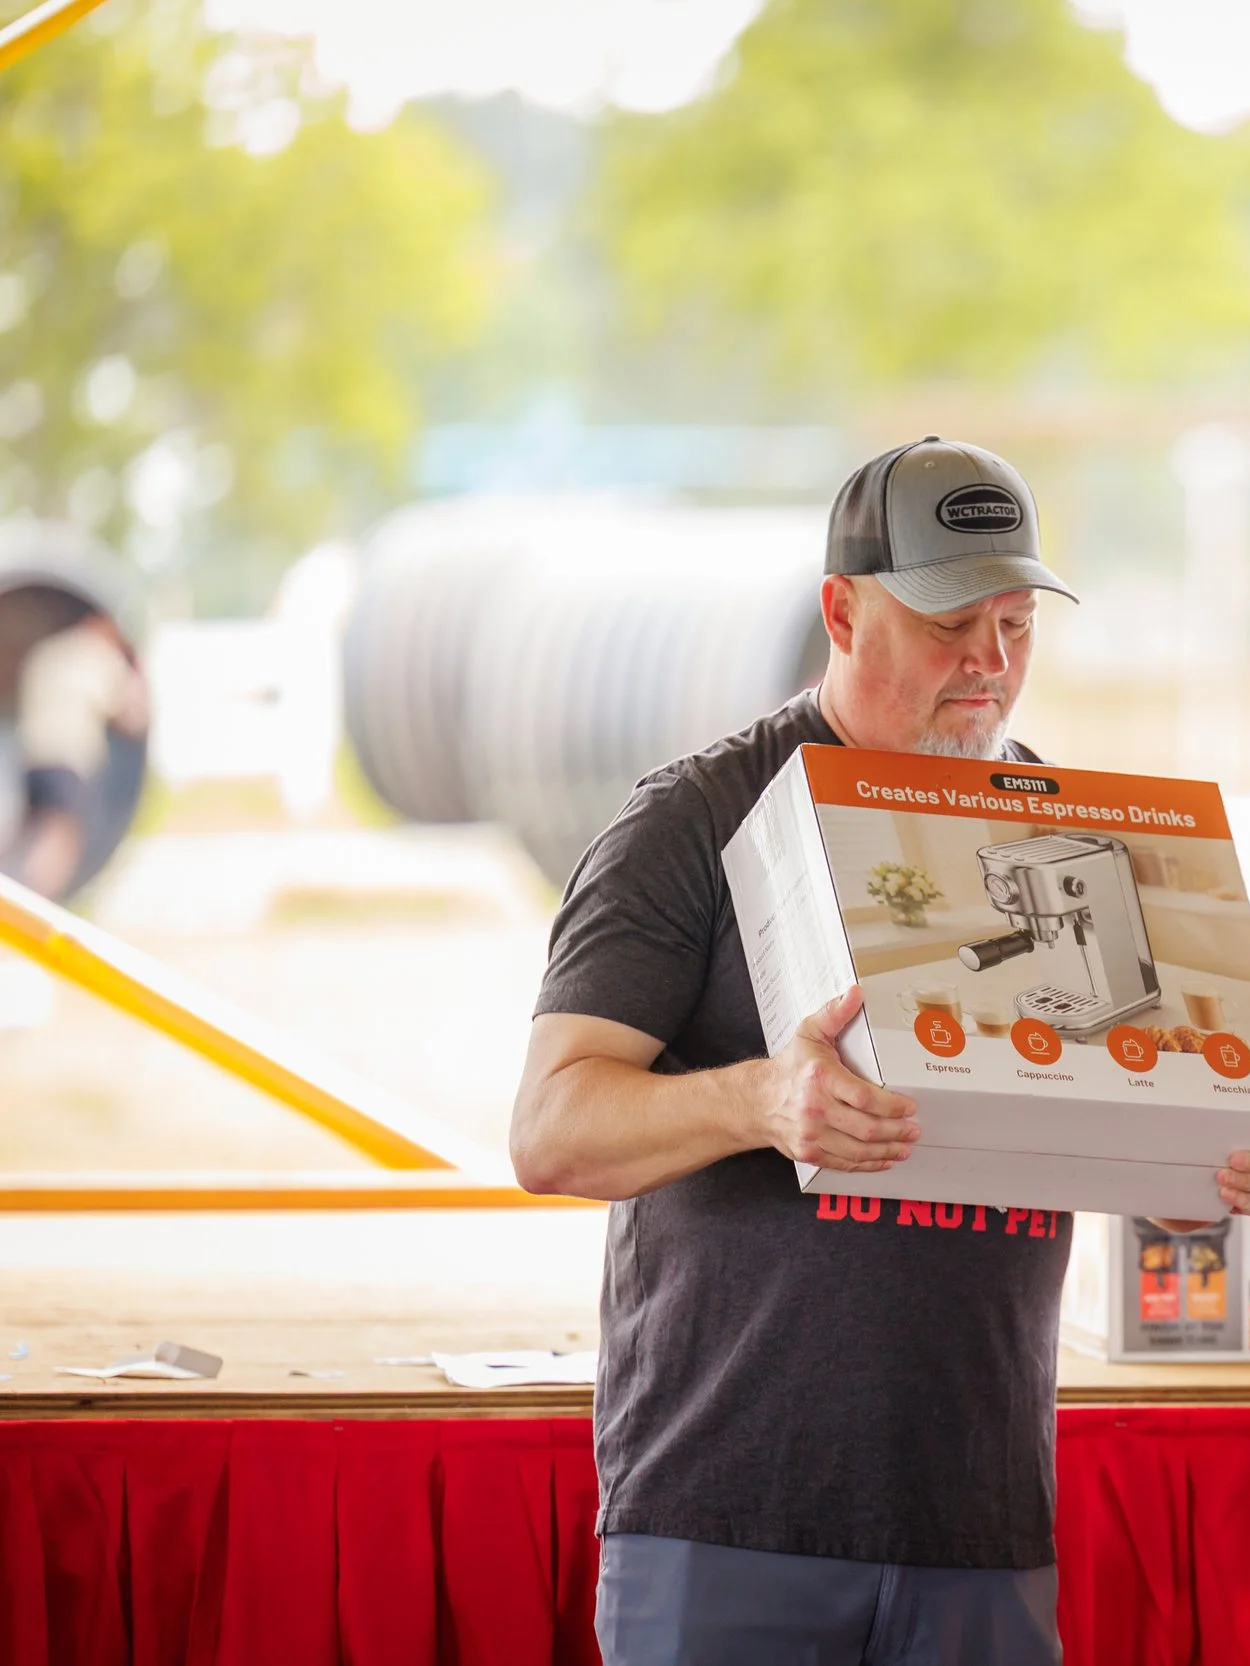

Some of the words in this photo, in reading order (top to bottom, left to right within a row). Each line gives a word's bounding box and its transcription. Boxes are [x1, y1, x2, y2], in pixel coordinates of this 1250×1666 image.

[946, 505, 1016, 518] WCTRACTOR
[1003, 776, 1047, 792] EM3111
[856, 780, 940, 805] Creates
[942, 789, 1024, 813] Various
[1026, 796, 1124, 822] Espresso
[1128, 806, 1196, 828] Drinks
[925, 1062, 971, 1074] Espresso
[1016, 1069, 1074, 1082] Cappuccino
[1128, 1078, 1155, 1088] Latte
[816, 1193, 881, 1222] DO
[896, 1198, 987, 1232] NOT
[1004, 1207, 1060, 1239] PET
